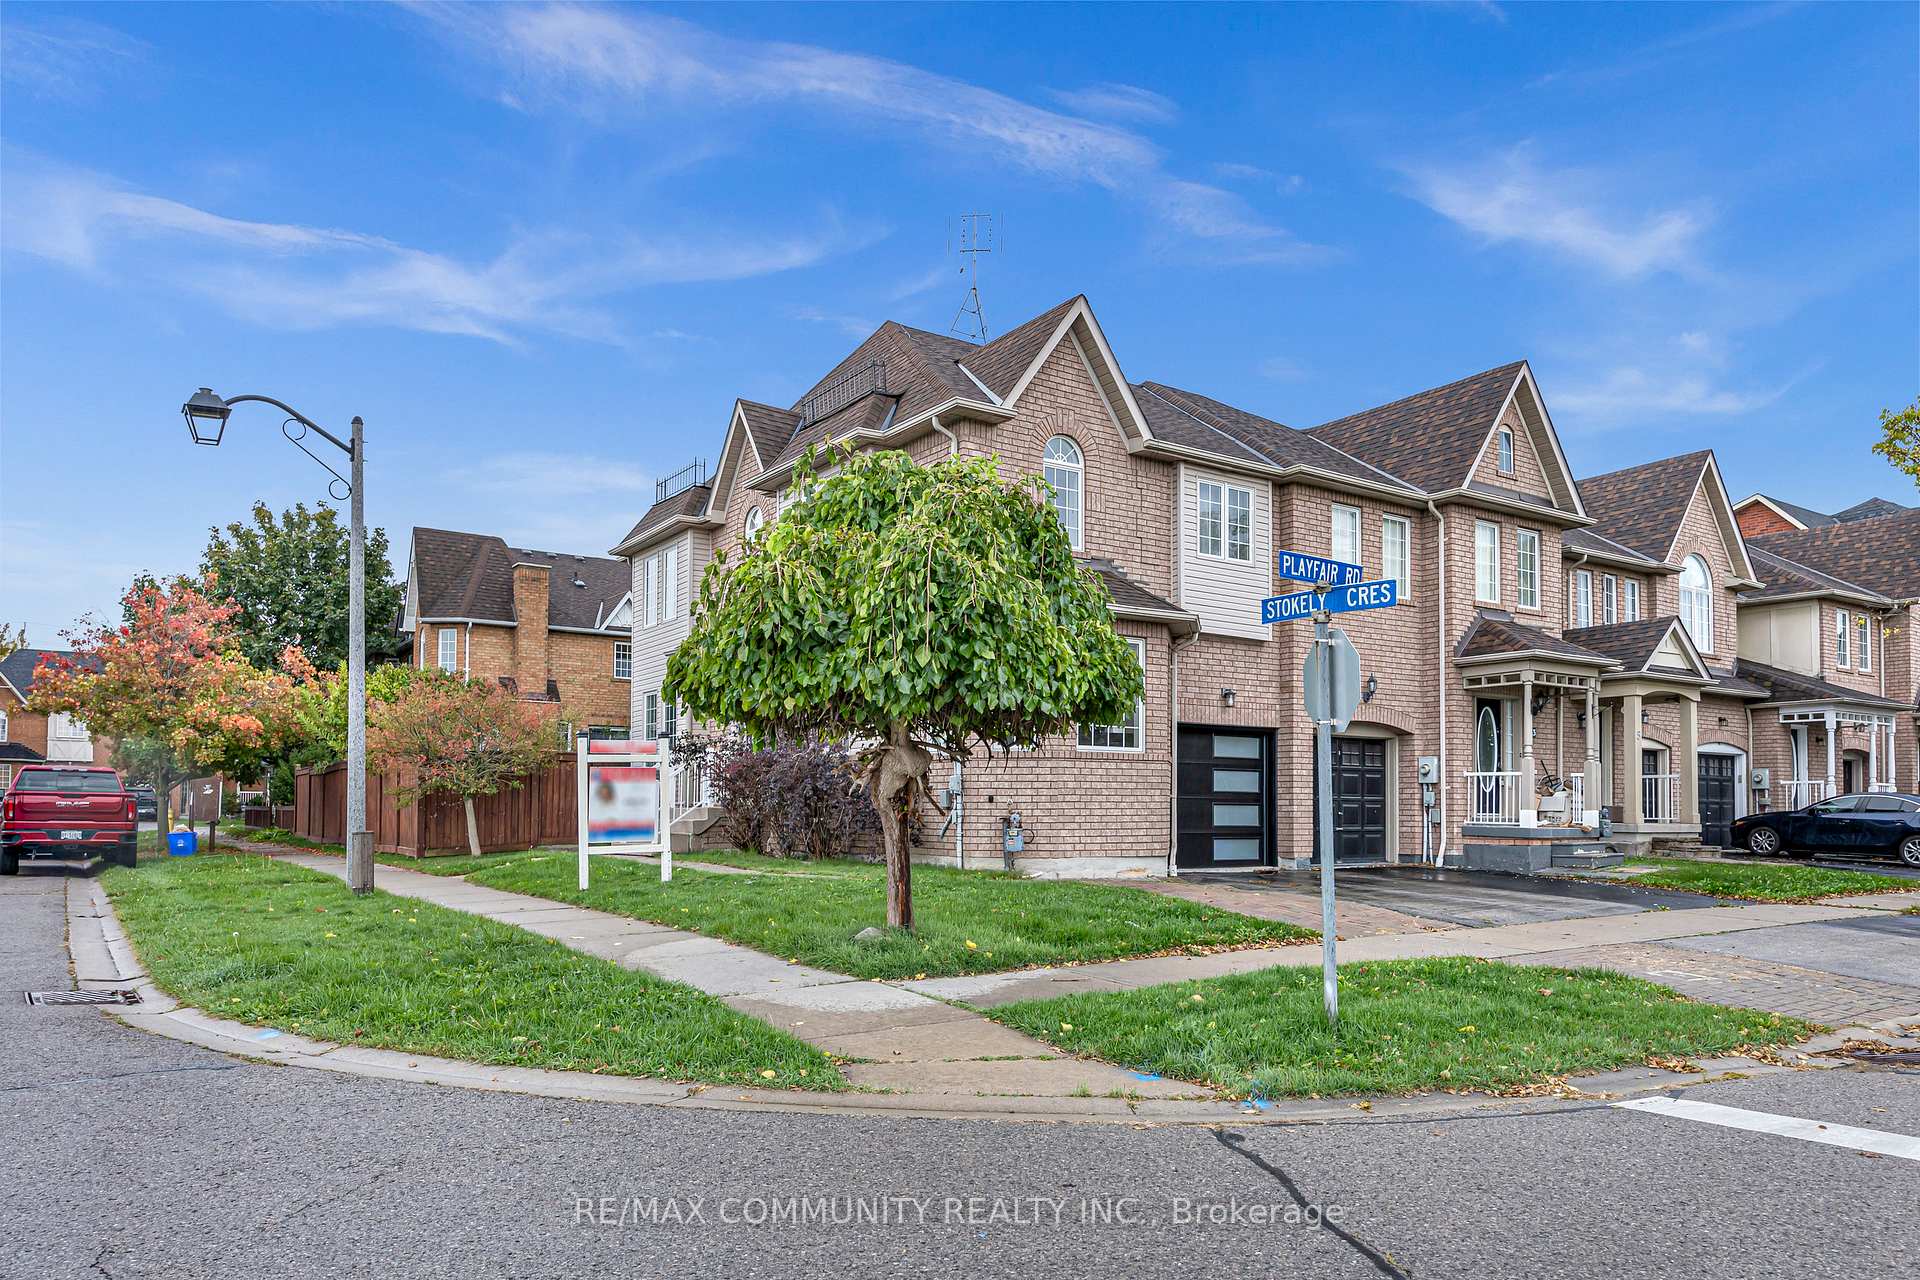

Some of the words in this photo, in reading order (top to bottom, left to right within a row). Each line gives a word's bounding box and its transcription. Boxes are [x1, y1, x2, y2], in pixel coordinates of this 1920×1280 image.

[1283, 555, 1338, 583] PLAYFAIR
[1345, 567, 1360, 584] RD
[1266, 592, 1327, 619] STOKELY
[1346, 583, 1391, 607] CRES
